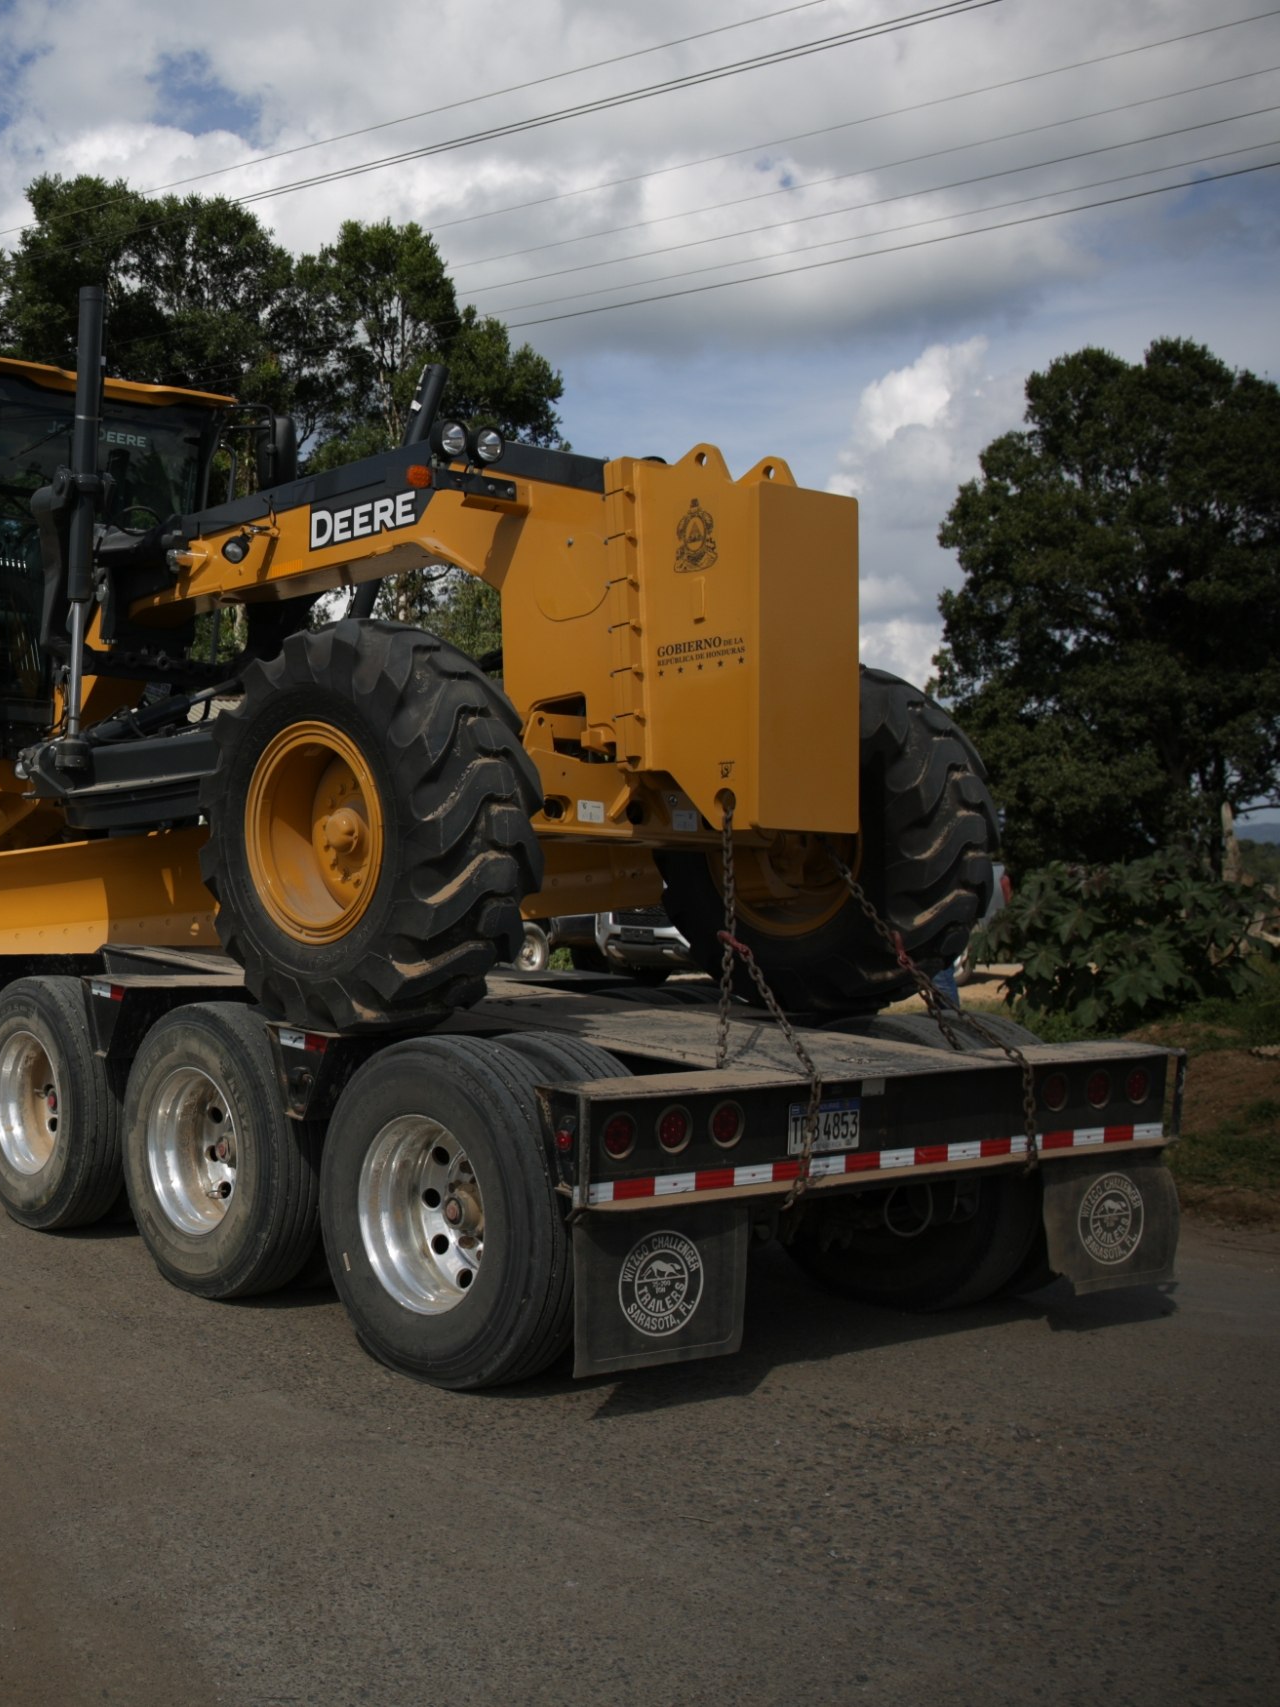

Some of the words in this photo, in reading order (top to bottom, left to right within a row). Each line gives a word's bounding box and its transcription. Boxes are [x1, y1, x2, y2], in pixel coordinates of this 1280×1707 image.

[310, 490, 416, 549] DEERE
[657, 636, 723, 658] GOBIERNO
[695, 652, 705, 660] DE
[706, 646, 746, 659] HONDURAS
[823, 1110, 859, 1141] 4853
[622, 1243, 650, 1283] WITZCO
[652, 1235, 700, 1273] CHALLENGER
[638, 1281, 685, 1313] TRAILERS
[627, 1302, 681, 1331] SARASOTA,
[679, 1300, 695, 1317] FL.
